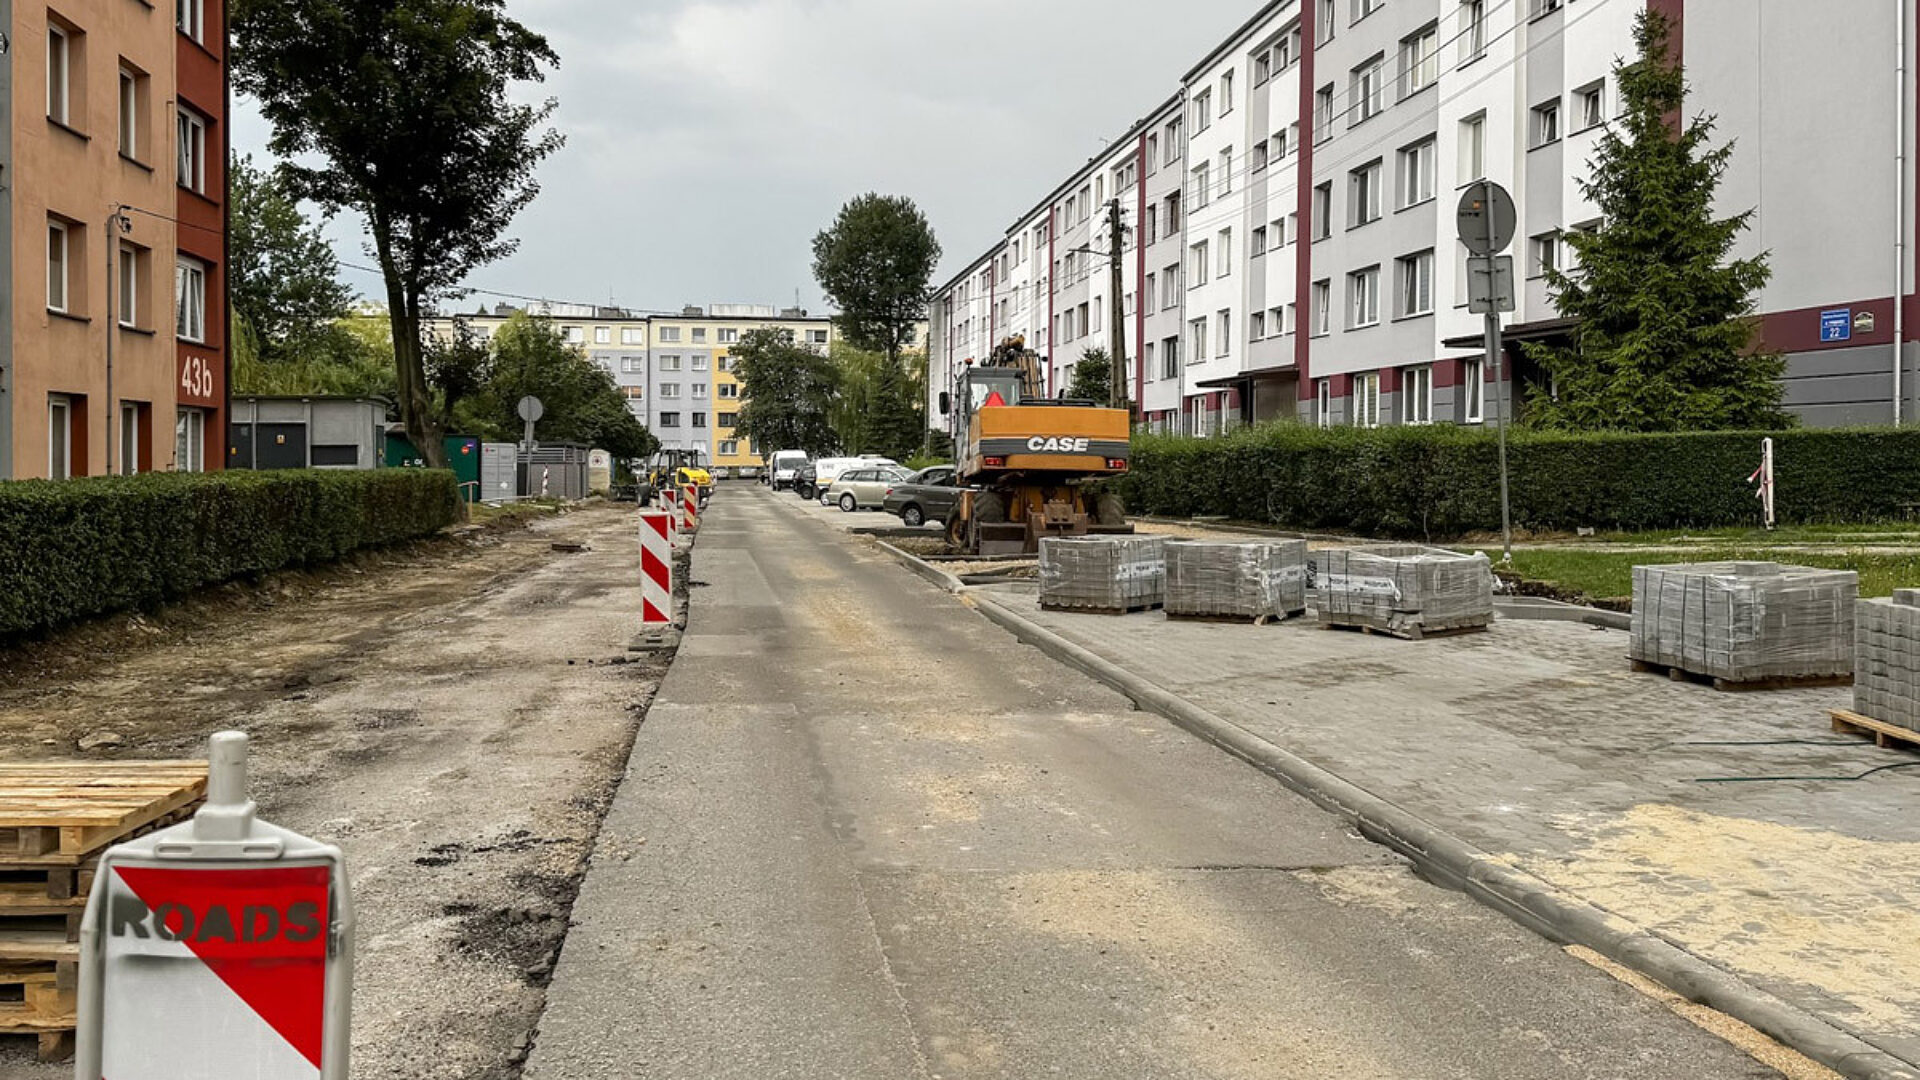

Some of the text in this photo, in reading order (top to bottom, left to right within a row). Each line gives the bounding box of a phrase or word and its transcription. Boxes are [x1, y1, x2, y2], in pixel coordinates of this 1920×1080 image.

[182, 355, 212, 398] 43b
[1027, 436, 1089, 452] CASE
[111, 896, 322, 943] ROADS
